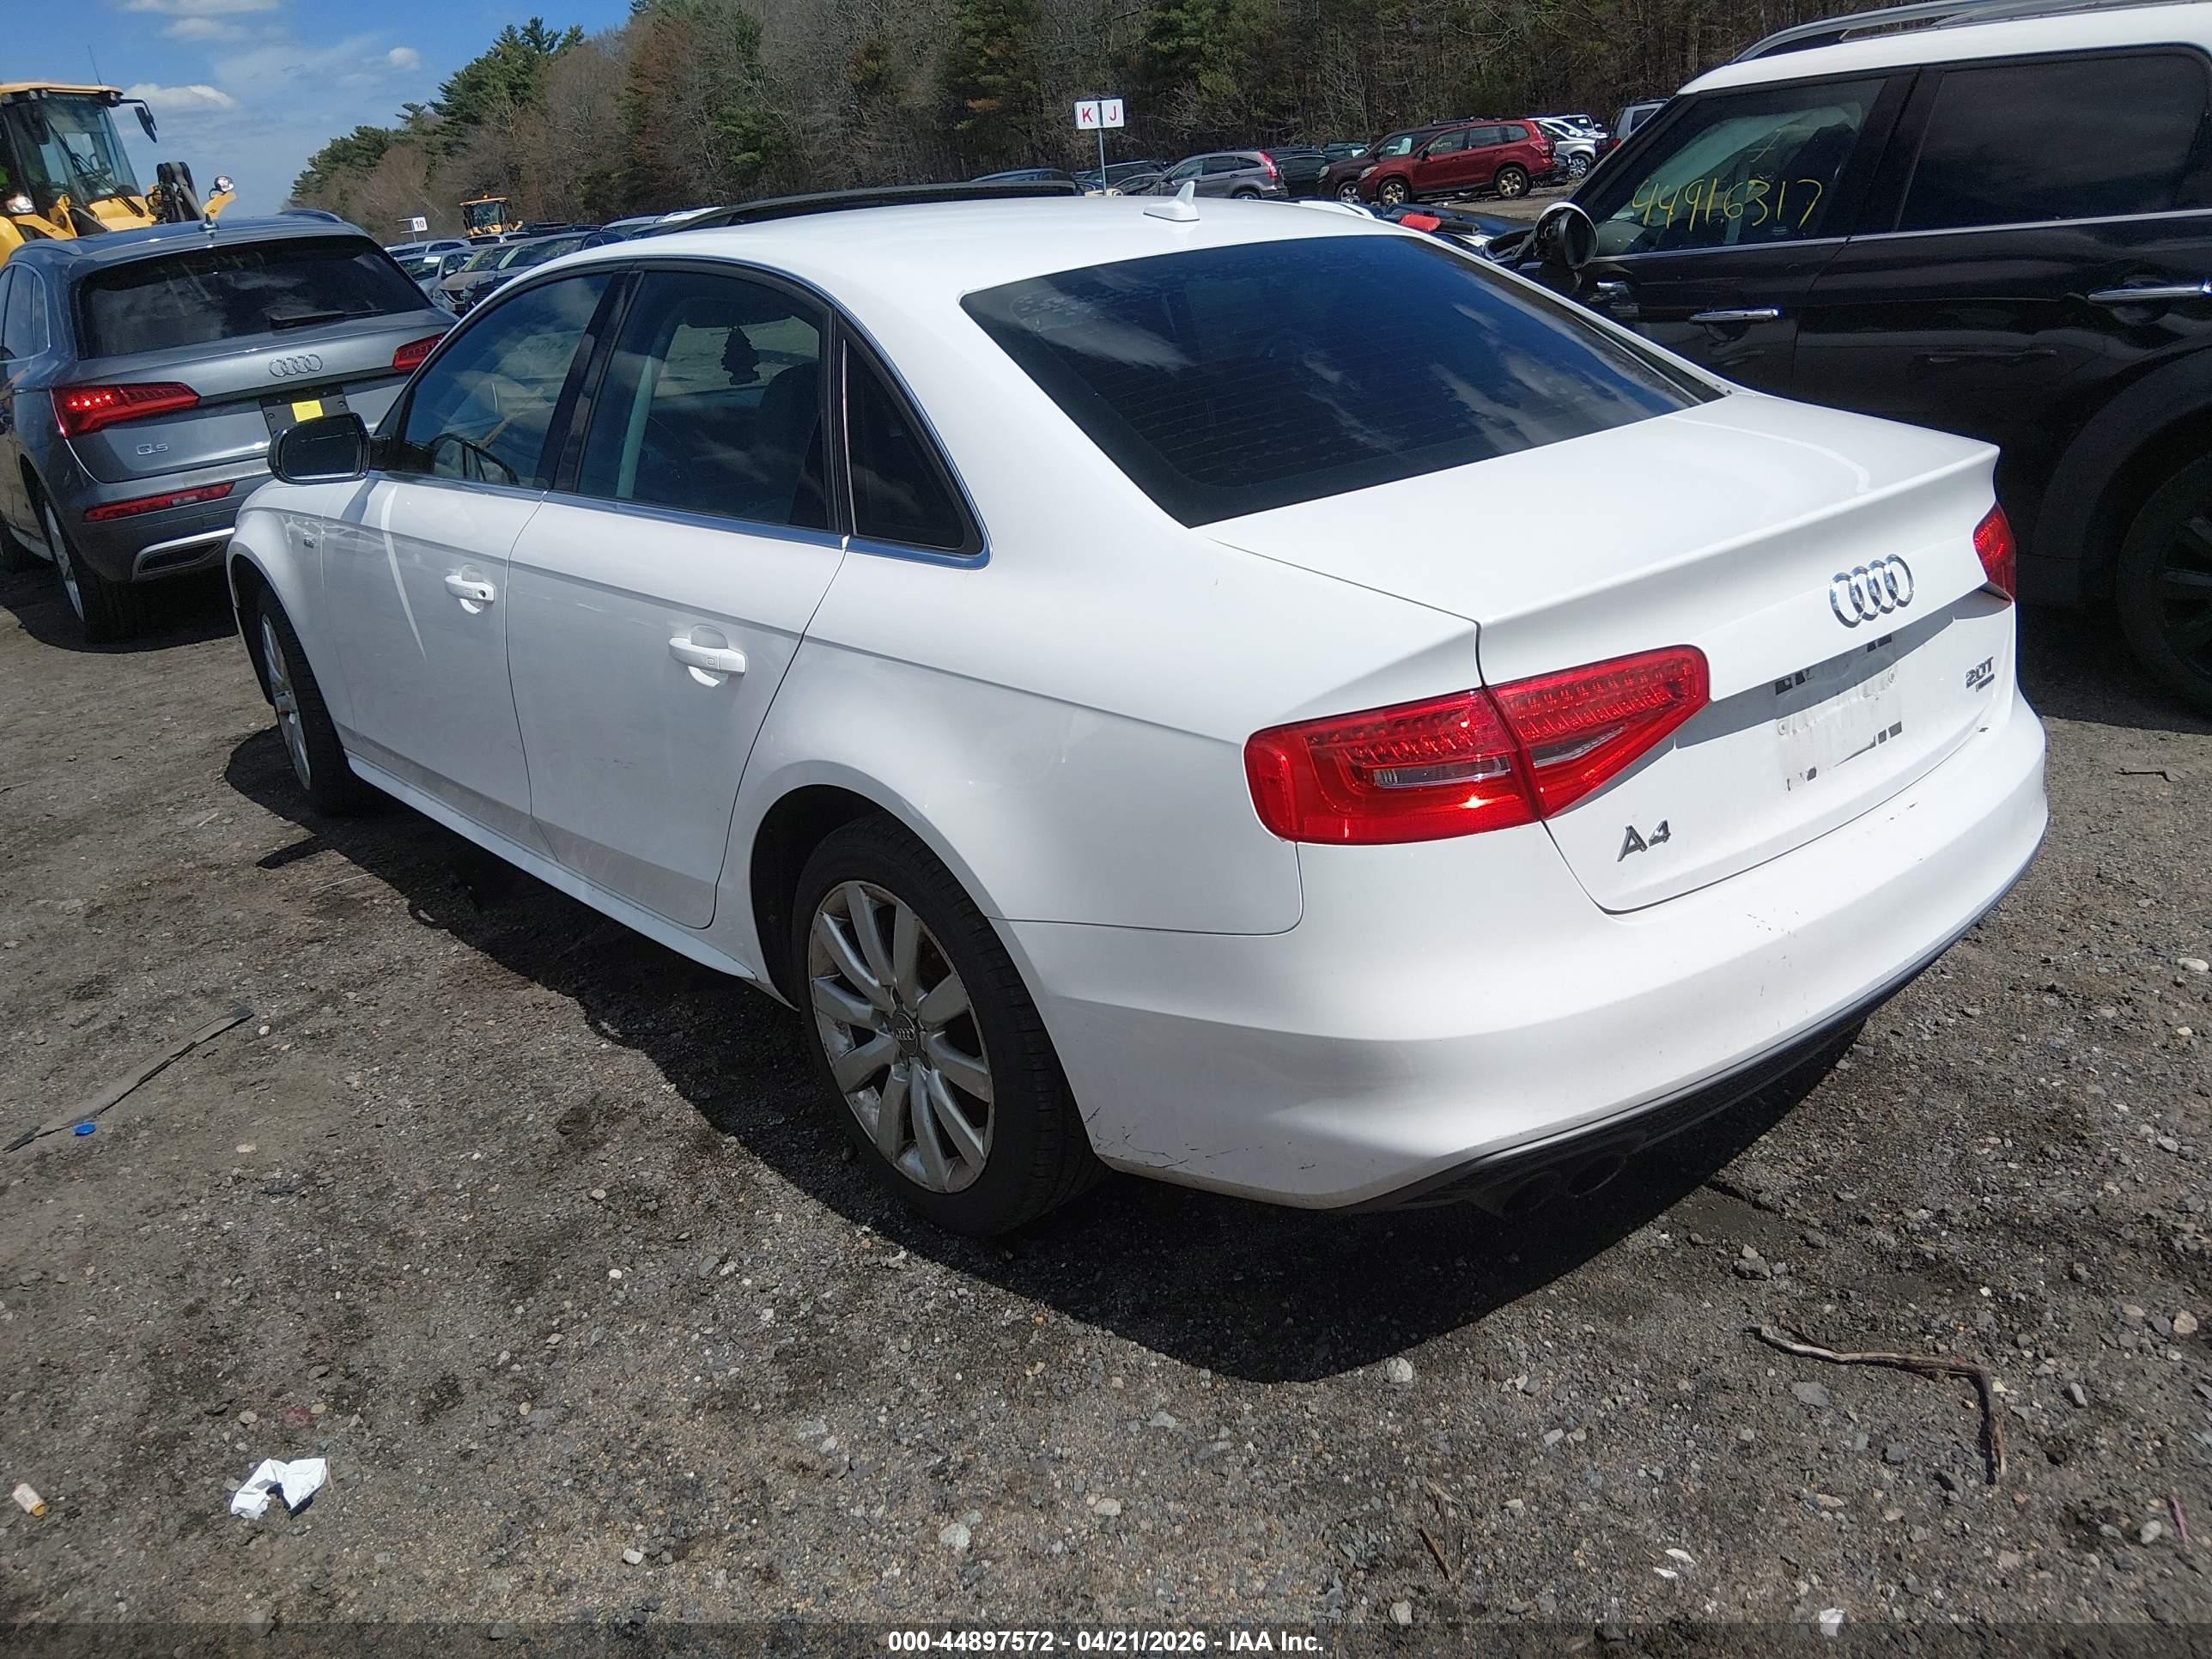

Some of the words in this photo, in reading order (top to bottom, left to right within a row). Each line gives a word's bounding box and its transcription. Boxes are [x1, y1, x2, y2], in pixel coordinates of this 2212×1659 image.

[1082, 106, 1093, 123] K
[1109, 105, 1117, 121] J
[1632, 178, 1822, 232] 44916317
[415, 220, 425, 228] 10
[1617, 819, 1671, 862] A4
